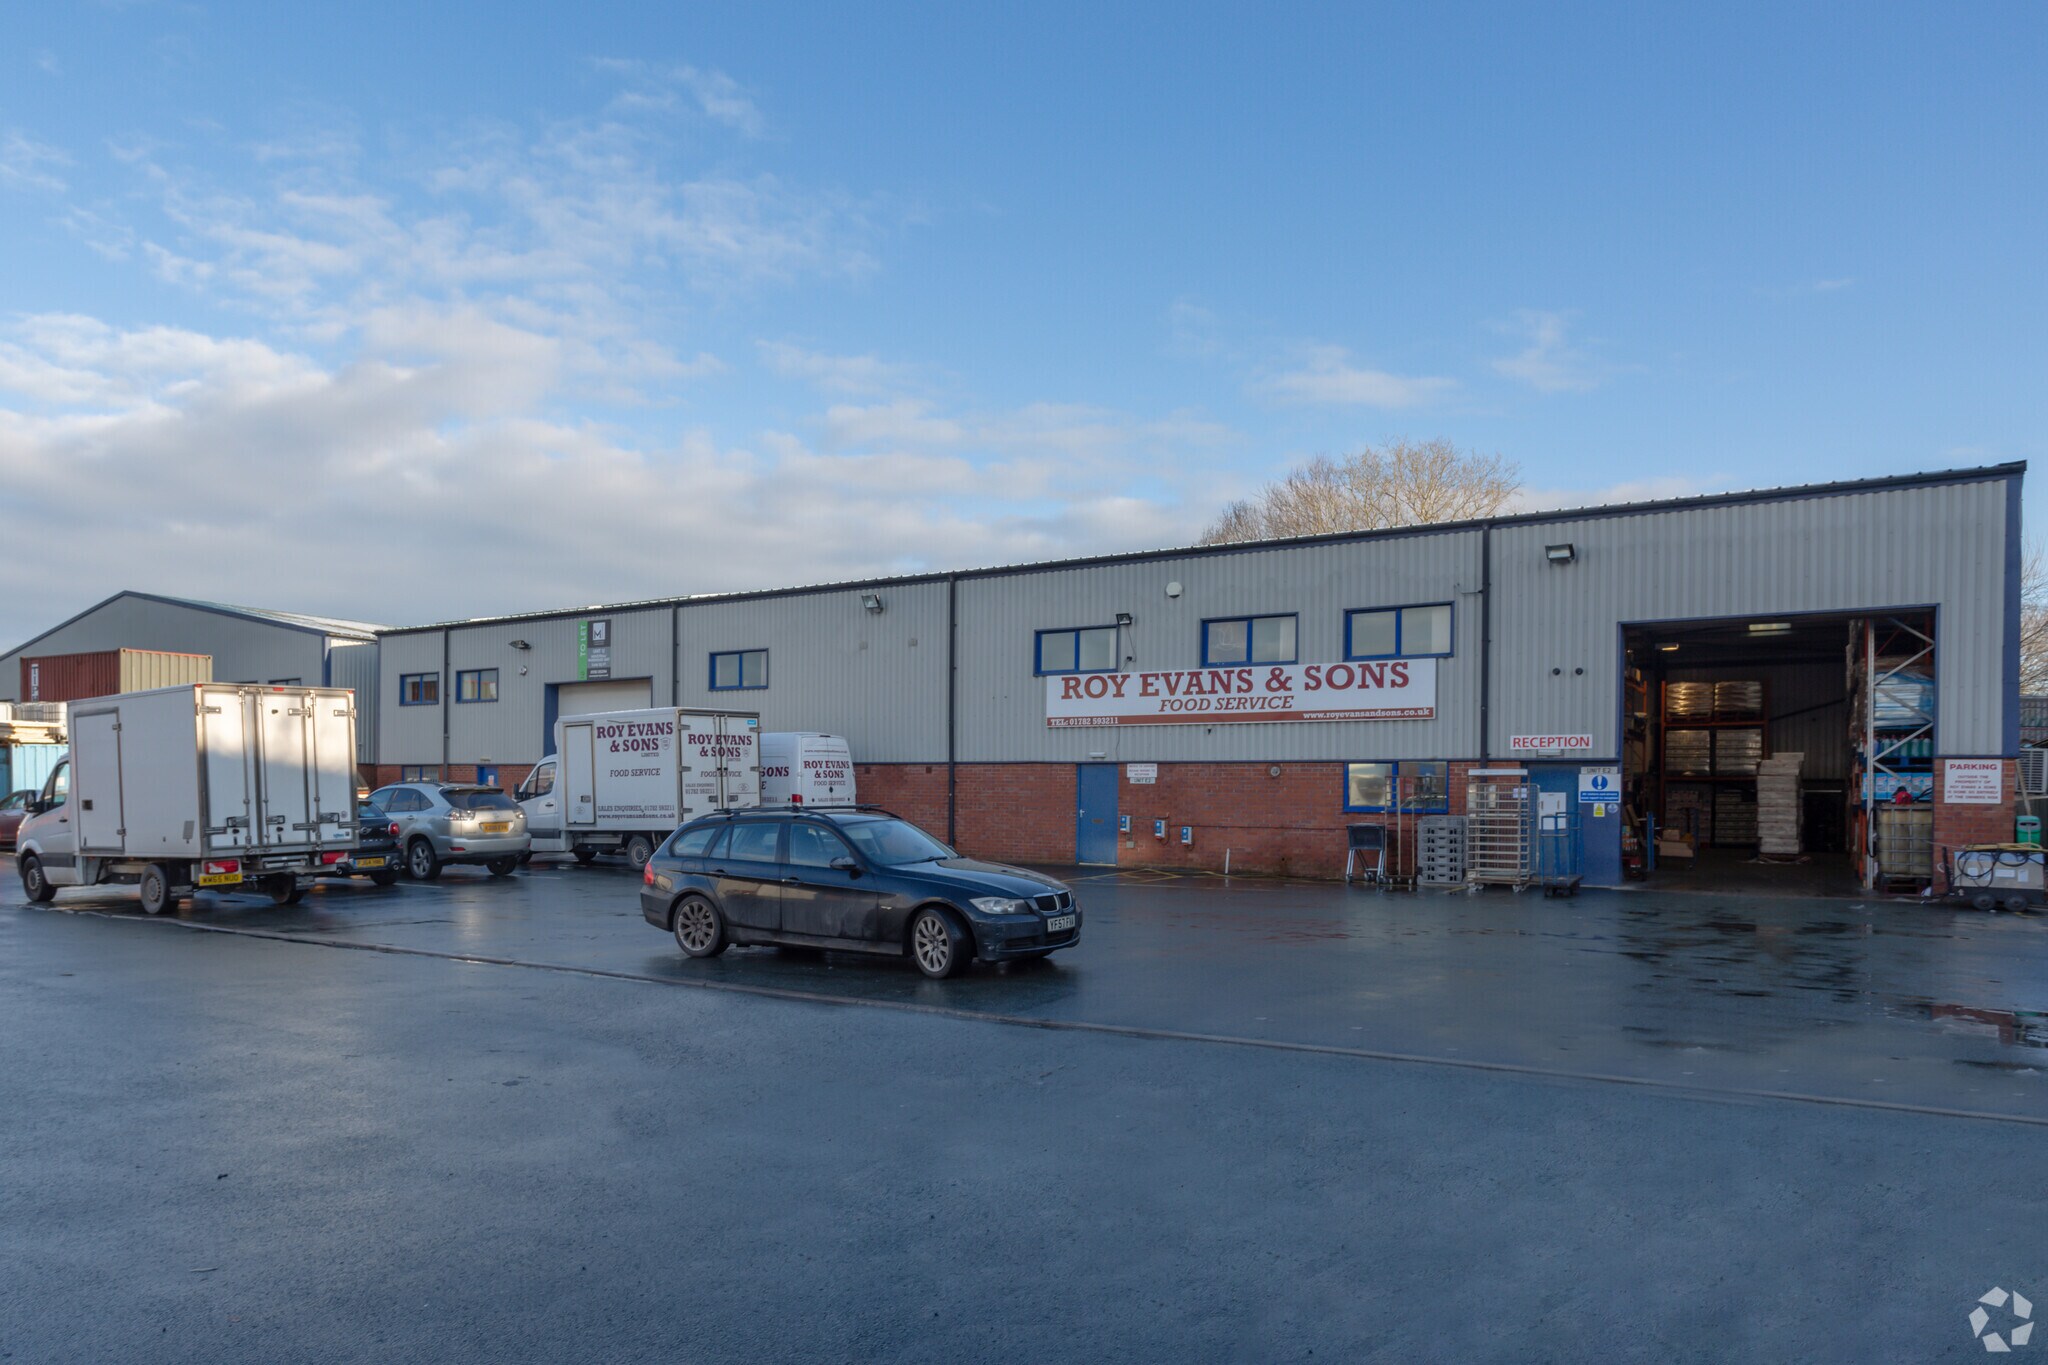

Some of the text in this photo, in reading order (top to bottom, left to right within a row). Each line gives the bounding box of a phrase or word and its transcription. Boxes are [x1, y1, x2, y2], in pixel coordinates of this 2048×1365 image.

[580, 643, 586, 656] TO
[1061, 662, 1410, 700] ROY EVANS & SONS
[1158, 696, 1294, 712] FOOD SERVICE
[1303, 708, 1430, 719] www.royevansandsons.co.uk
[1070, 718, 1091, 726] 01782
[1092, 717, 1118, 725] 593211
[596, 722, 673, 738] ROY EVANS
[610, 740, 620, 752] &
[623, 738, 658, 752] SONS
[688, 734, 752, 746] ROY EVANS
[1513, 736, 1590, 748] RECEPTION
[700, 746, 741, 757] & SONS
[804, 760, 850, 769] ROY EVANS
[631, 768, 660, 776] SERVICE
[814, 770, 844, 778] & SONS
[1050, 918, 1065, 929] YF57
